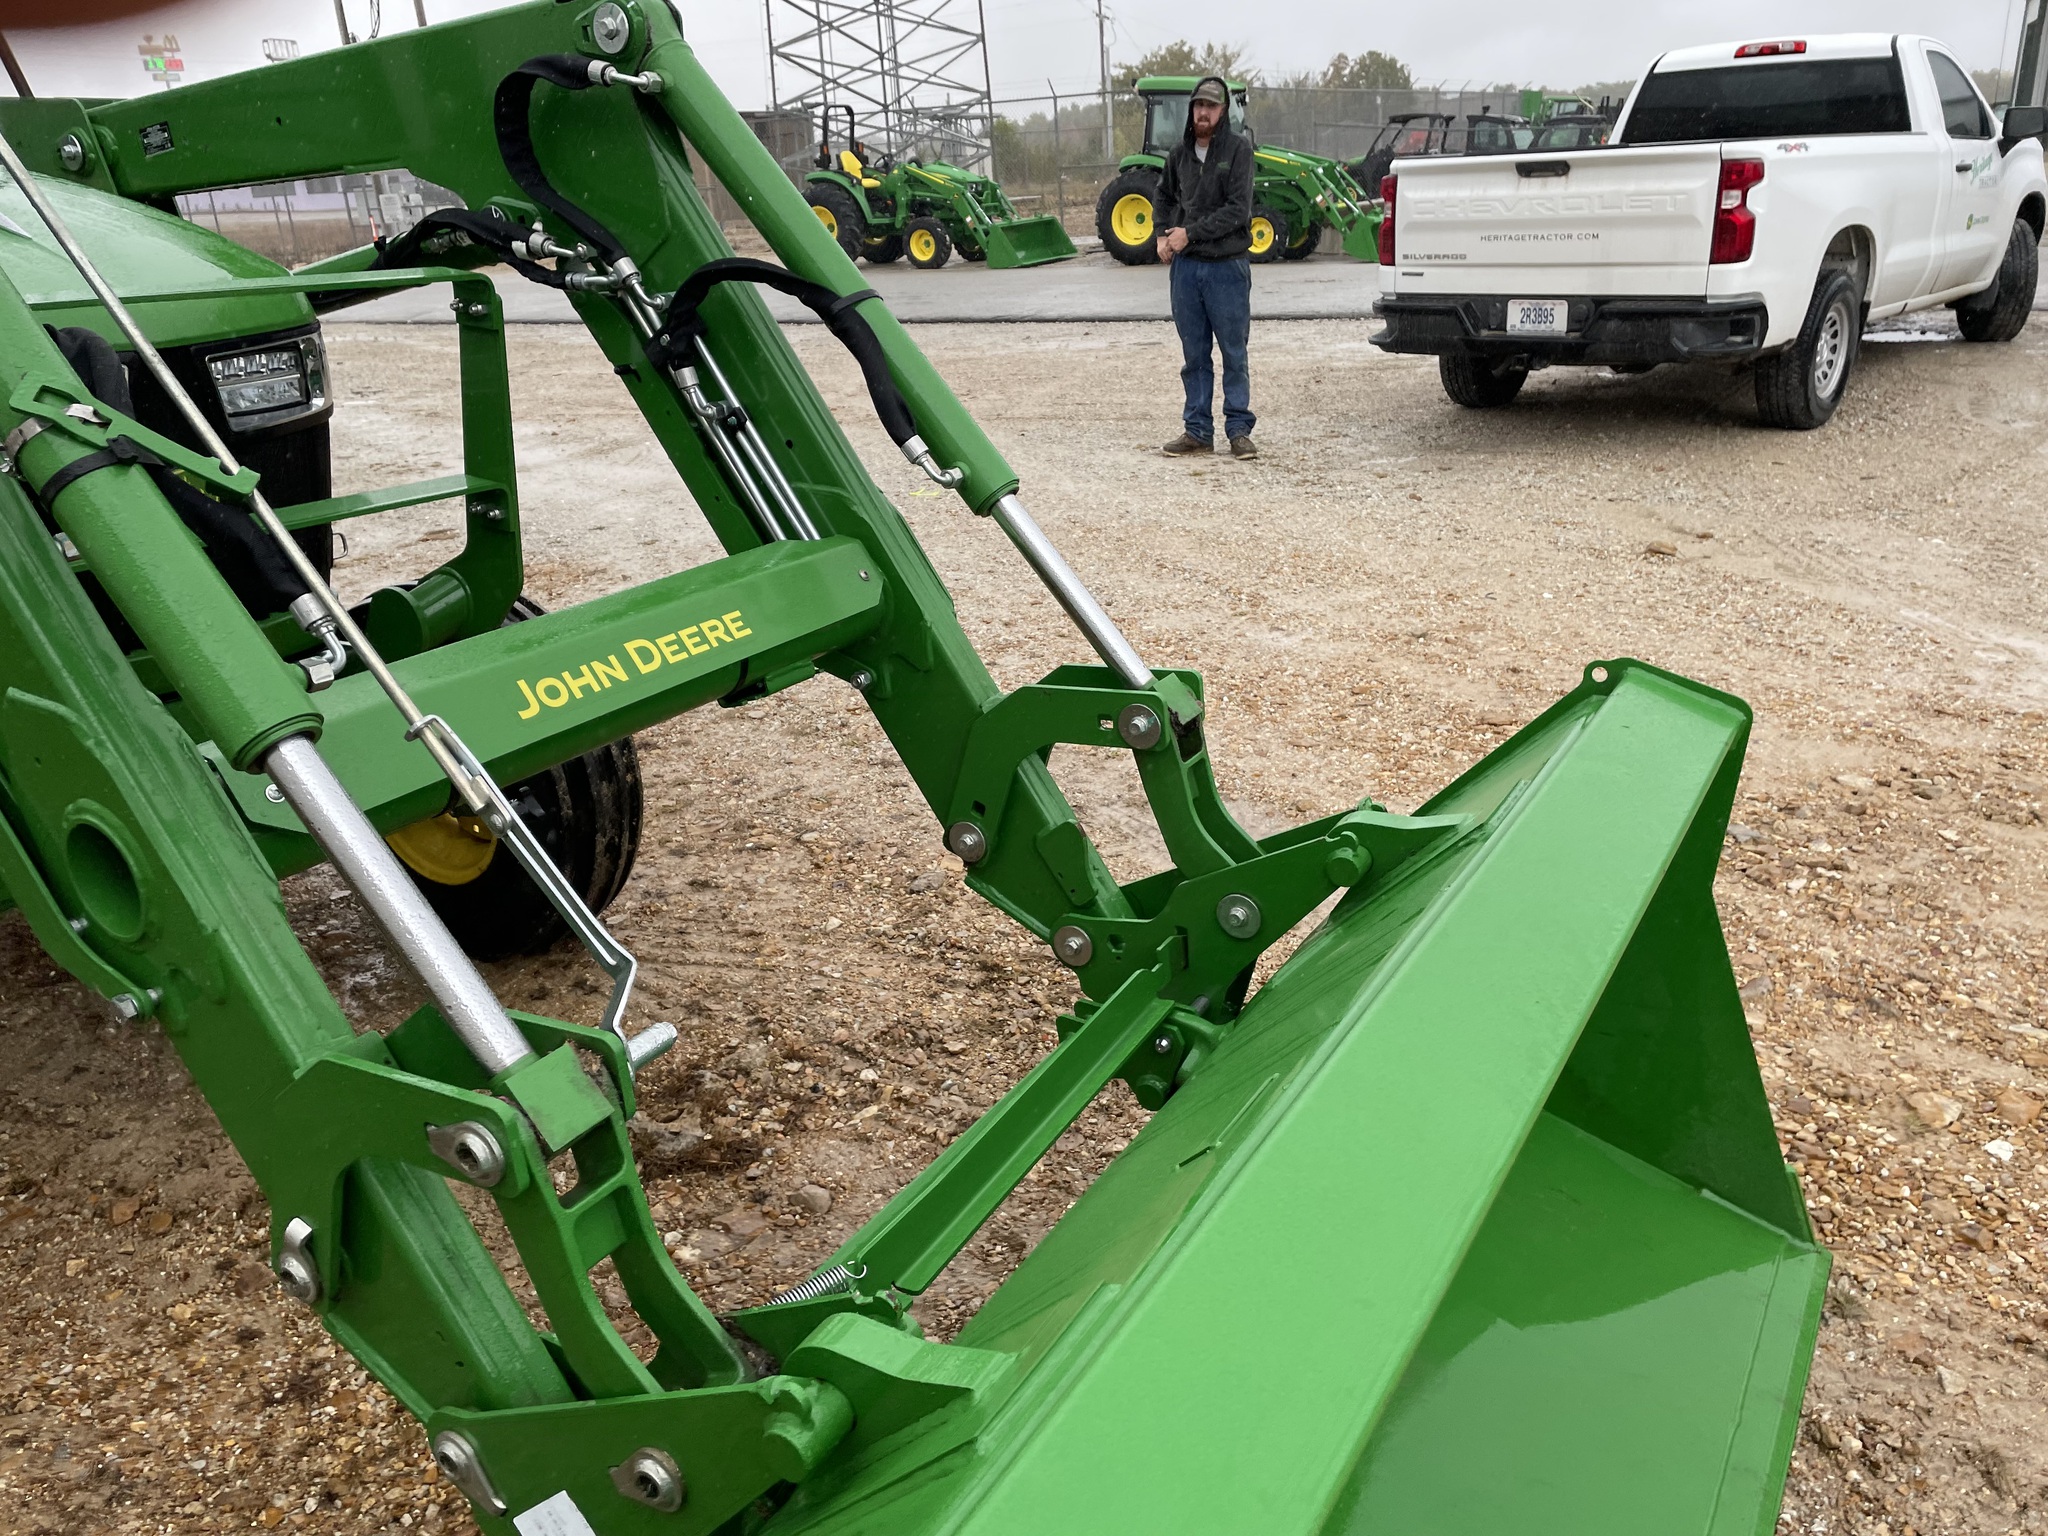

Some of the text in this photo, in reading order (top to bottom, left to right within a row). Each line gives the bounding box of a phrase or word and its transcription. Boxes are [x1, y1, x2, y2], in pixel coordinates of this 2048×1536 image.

[1412, 193, 1688, 218] CHEVROLET
[1520, 307, 1555, 325] 2R3B95
[516, 609, 753, 720] JOHN DEERE
